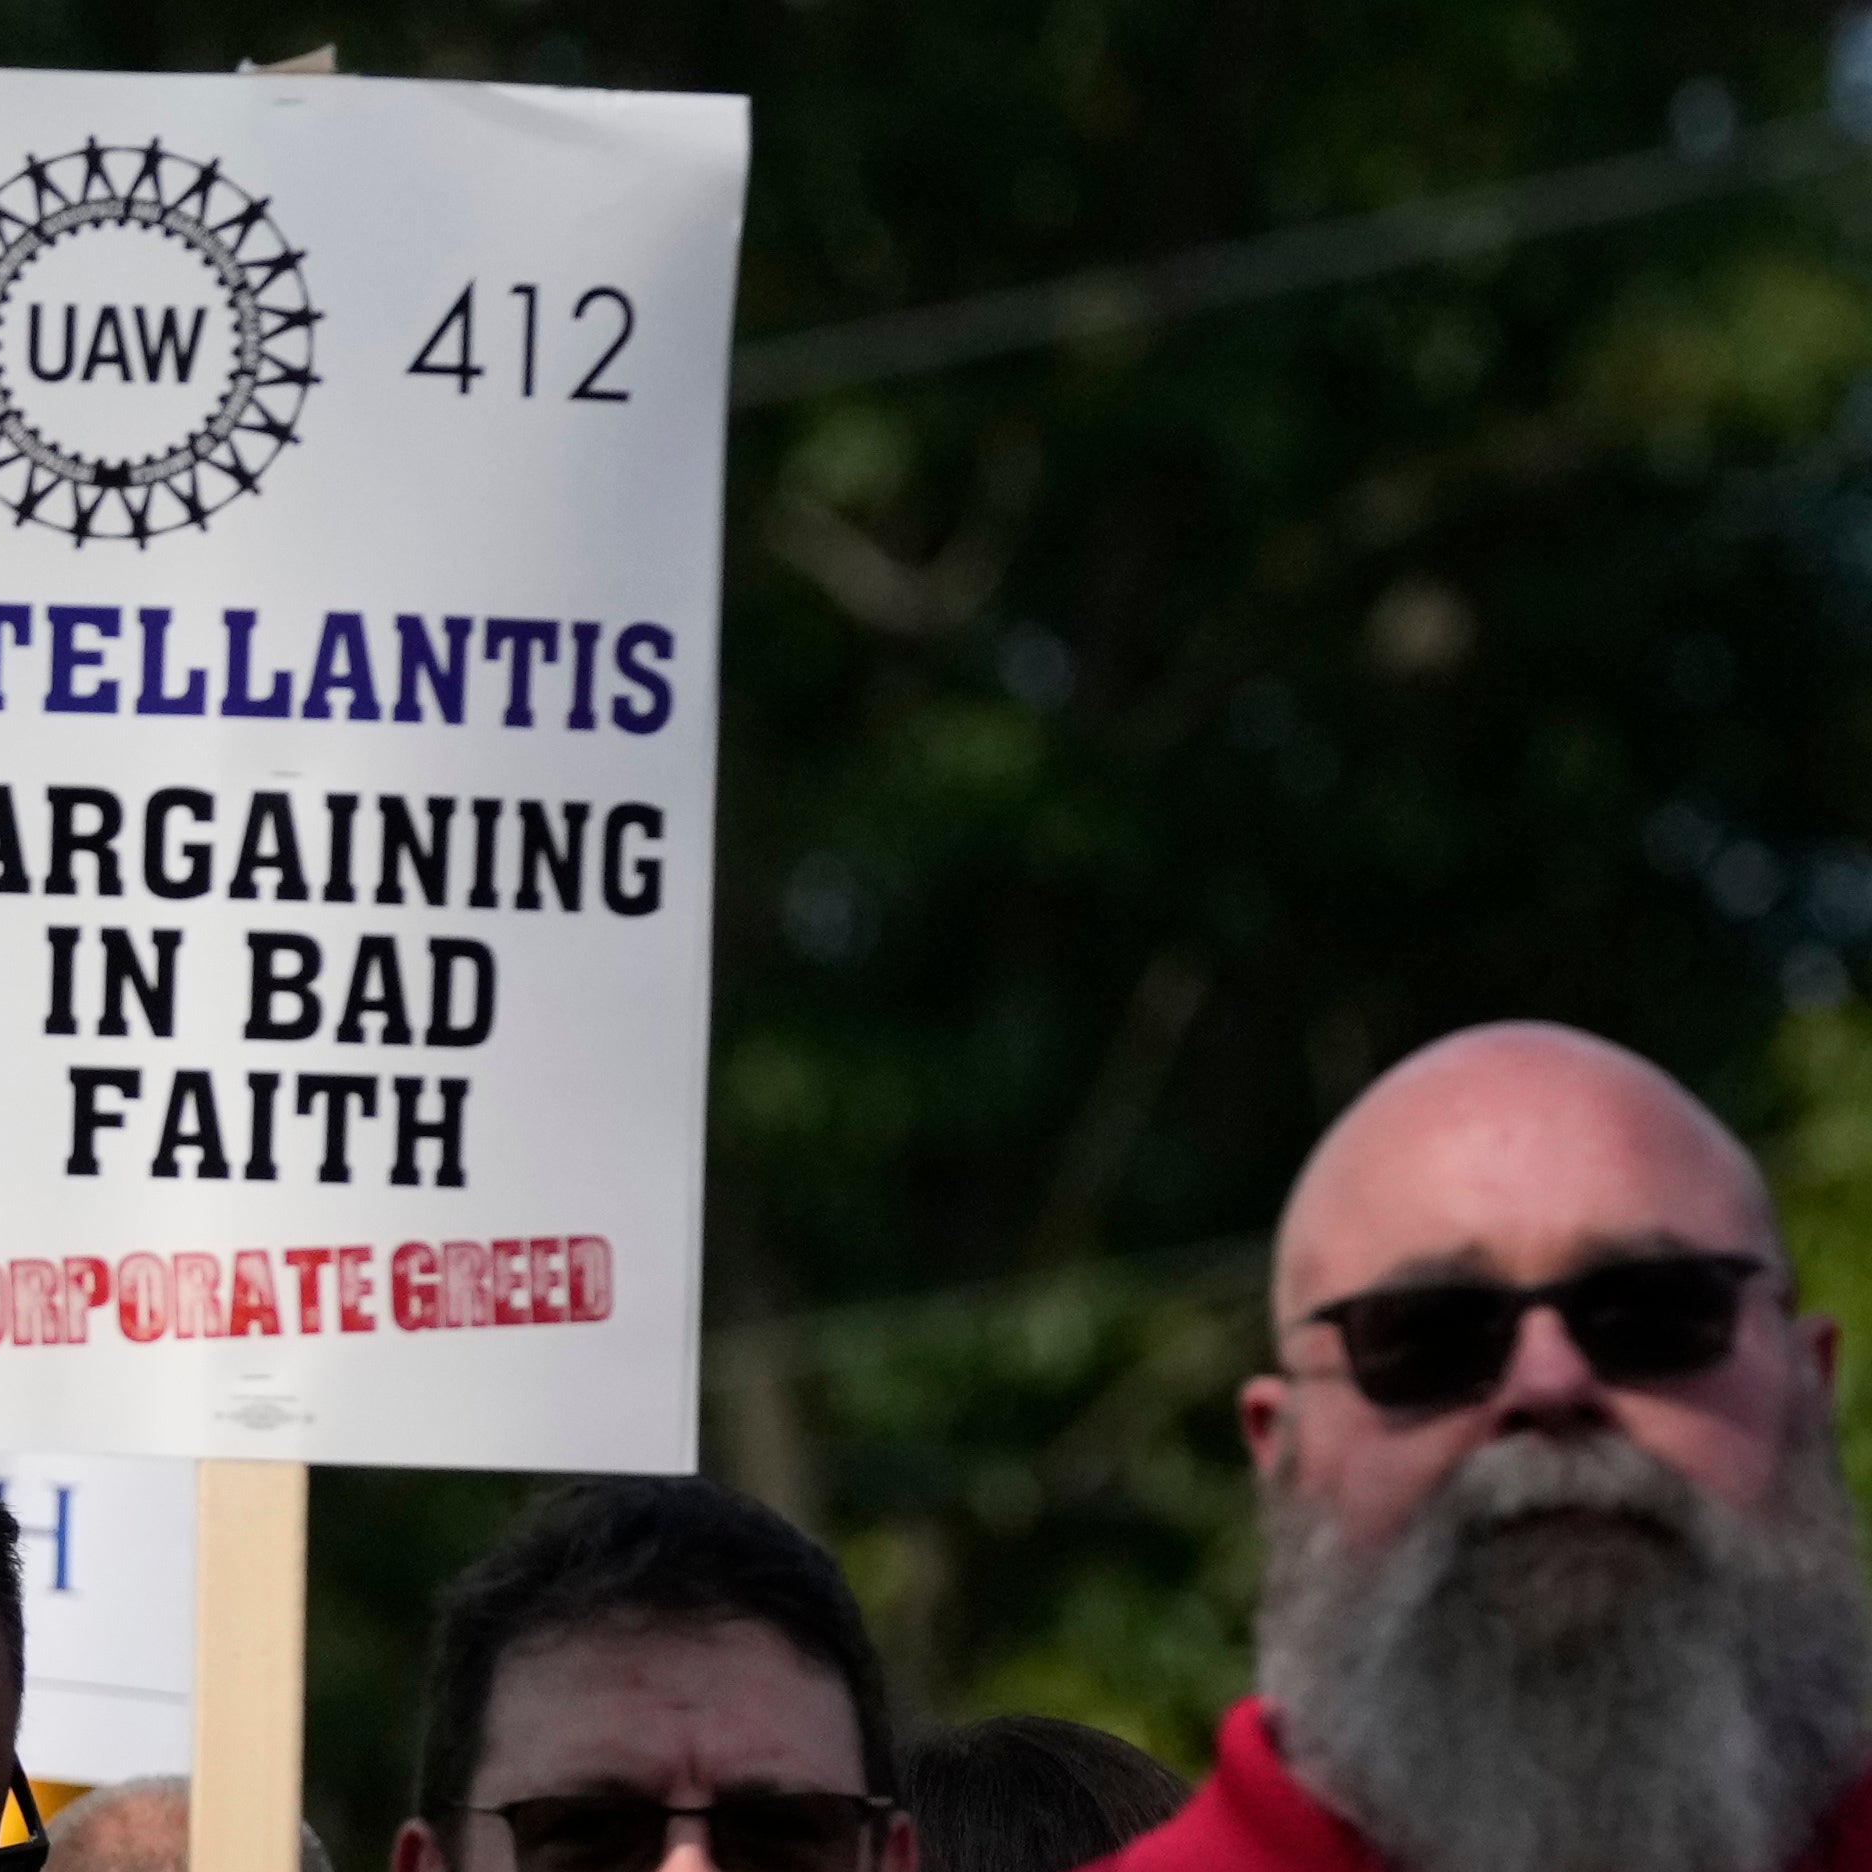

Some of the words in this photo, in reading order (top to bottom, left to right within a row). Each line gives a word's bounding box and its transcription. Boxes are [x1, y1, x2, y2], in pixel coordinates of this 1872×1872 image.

[28, 303, 207, 382] UAW
[407, 279, 637, 401] 412
[43, 926, 182, 1038] IN
[243, 931, 498, 1049] BAD
[64, 1066, 472, 1188] FAITH
[390, 1234, 613, 1339] GREED
